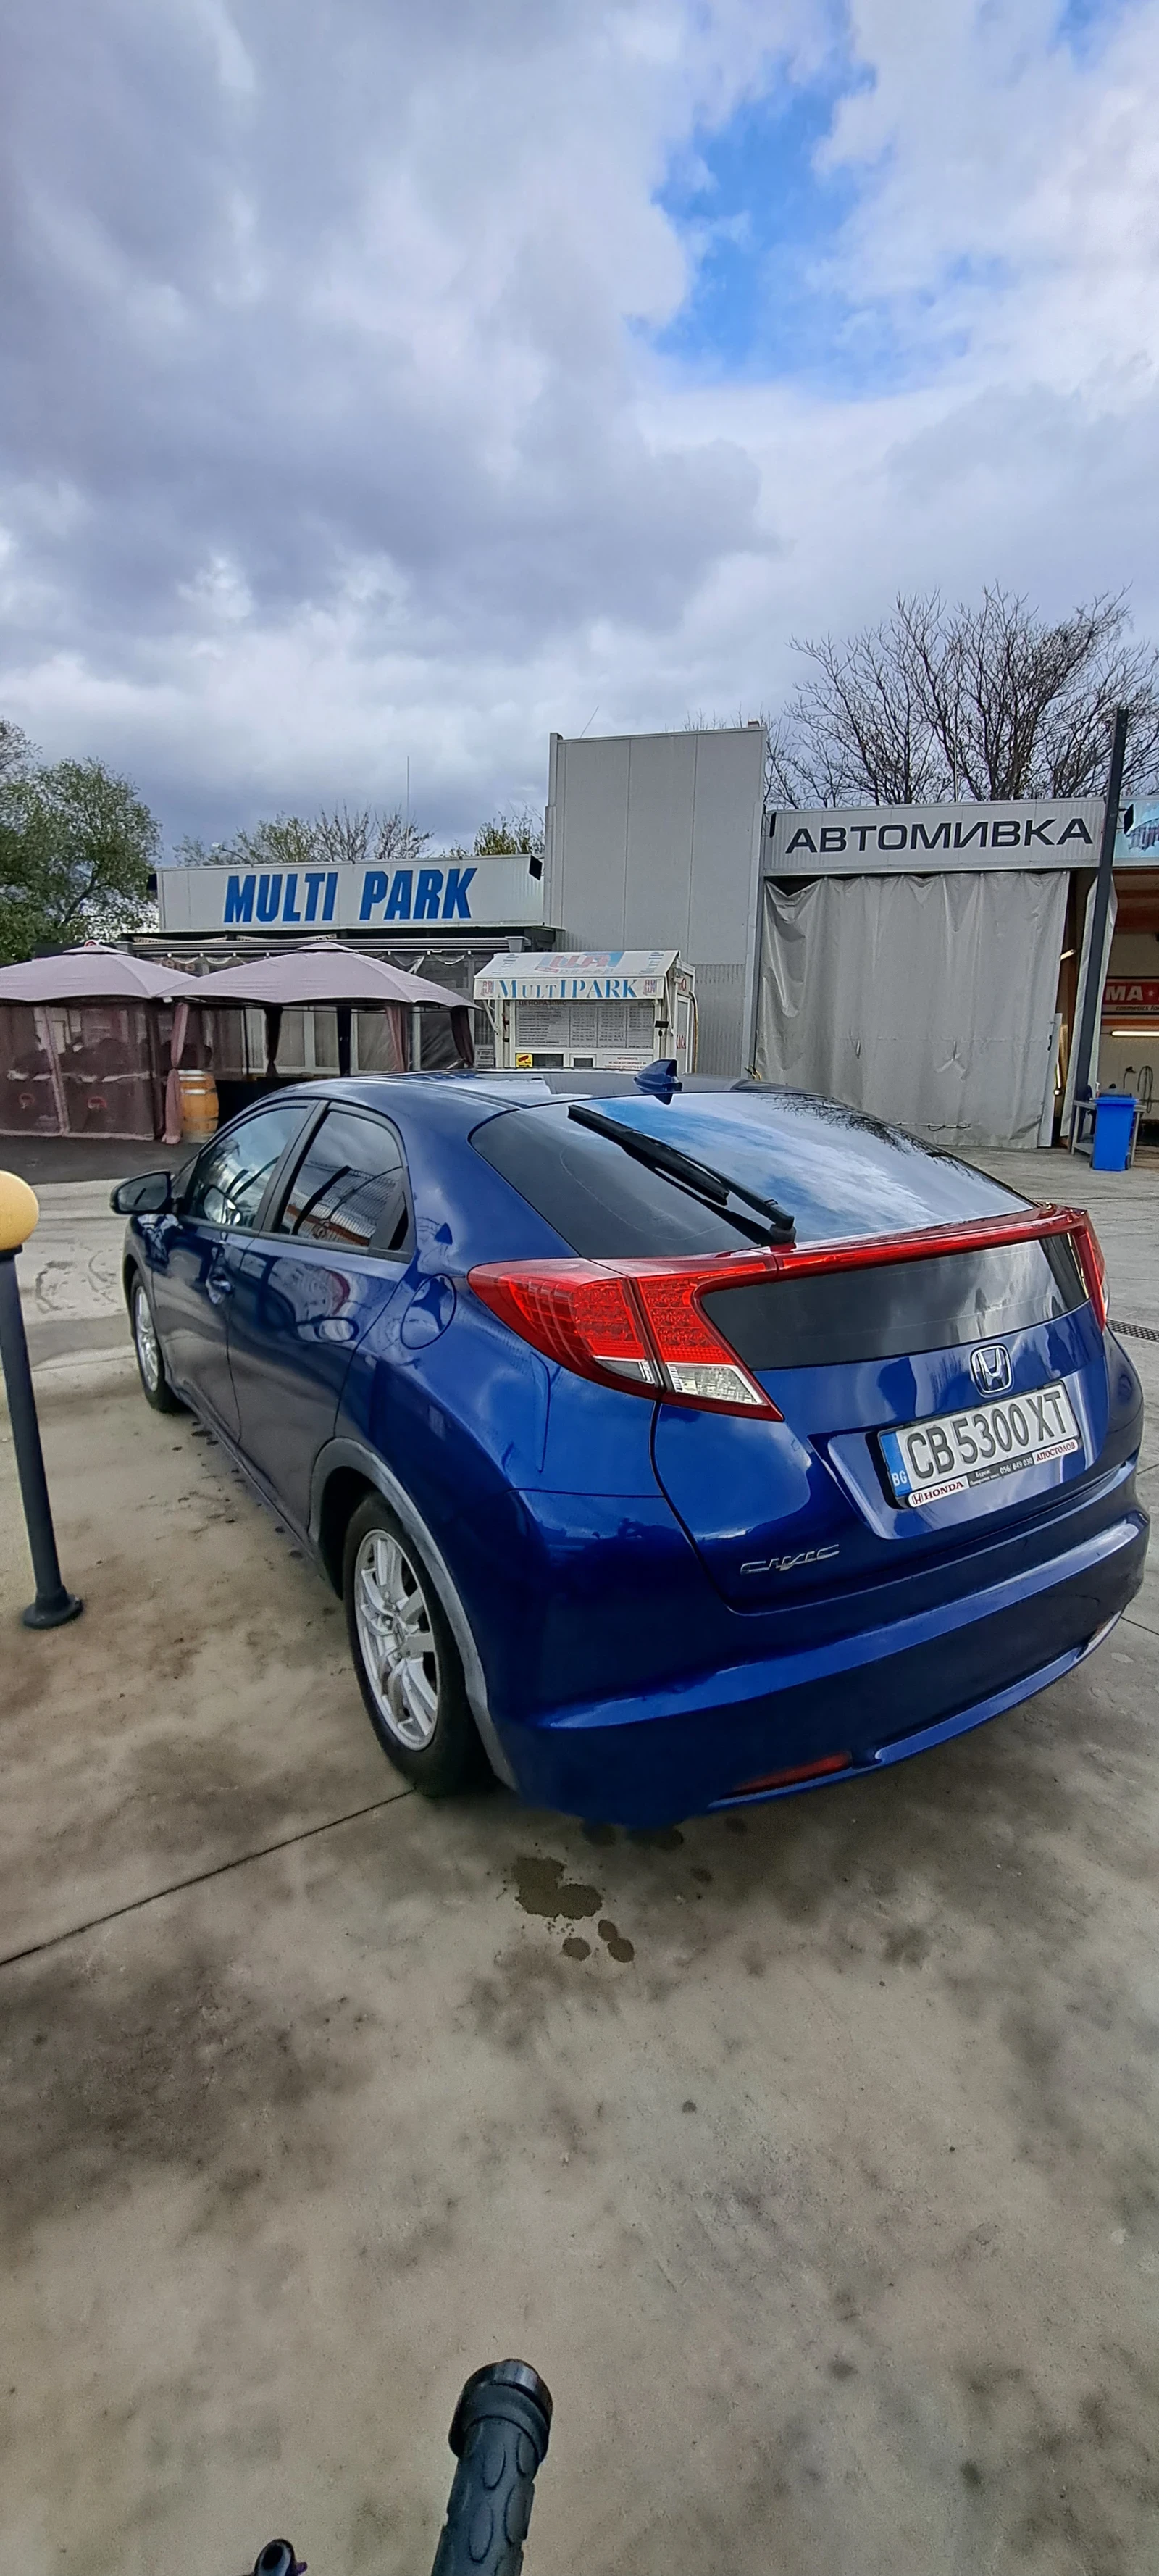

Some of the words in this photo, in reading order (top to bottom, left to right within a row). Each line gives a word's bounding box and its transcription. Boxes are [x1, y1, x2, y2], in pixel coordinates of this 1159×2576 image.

[784, 817, 1094, 854] АВТОМИВКА
[223, 872, 338, 923] MULTI
[359, 868, 478, 920] PARK
[952, 1404, 1029, 1464] 5300
[1036, 1441, 1076, 1462] АПОСТОЛОВ
[891, 1472, 908, 1486] BG
[924, 1481, 964, 1500] HONDA
[740, 1543, 840, 1574] CIVIC
